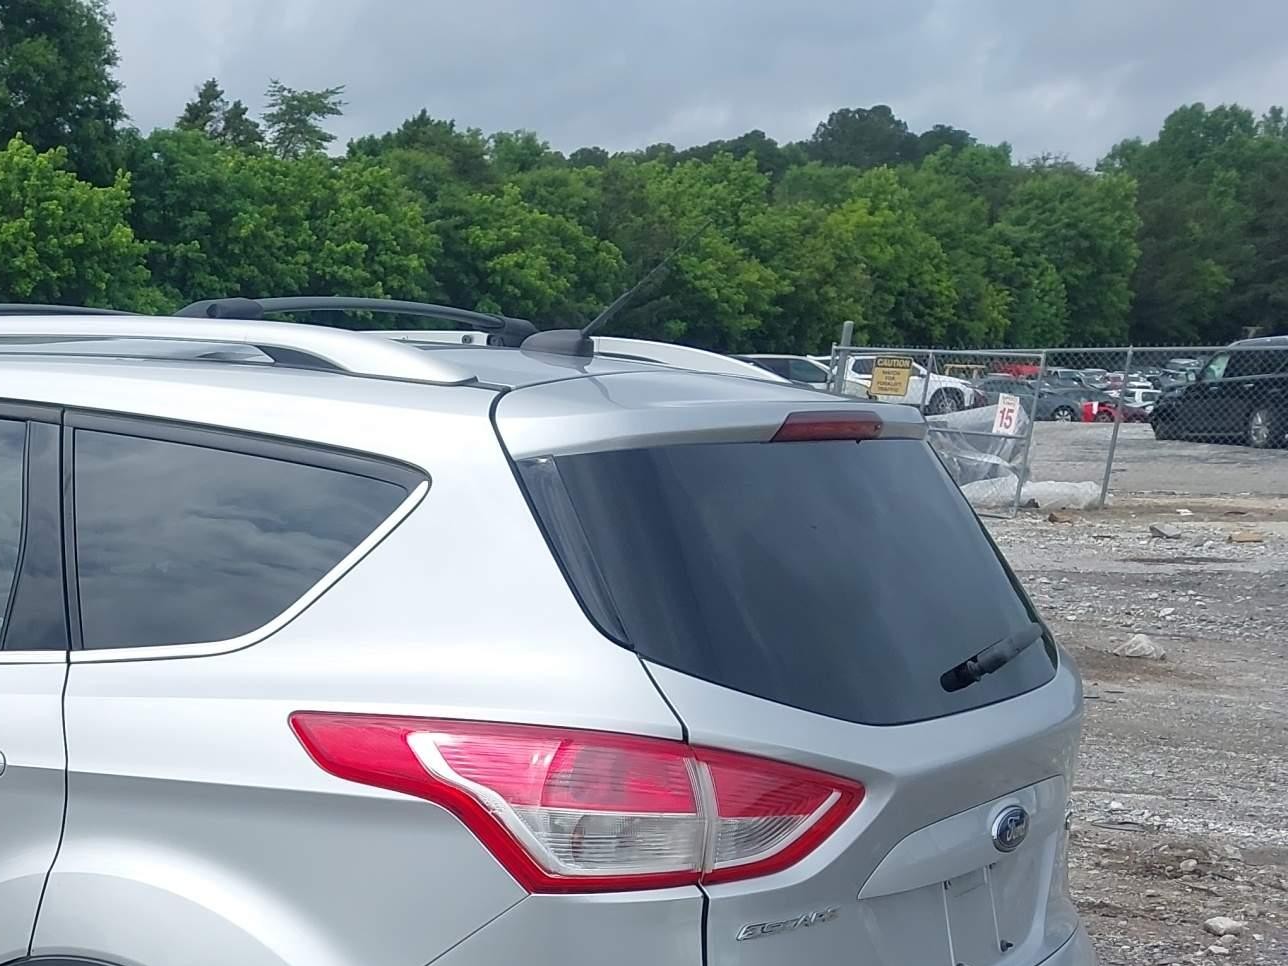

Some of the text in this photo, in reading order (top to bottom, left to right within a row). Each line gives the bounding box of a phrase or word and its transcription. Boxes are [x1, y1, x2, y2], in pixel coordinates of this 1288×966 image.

[877, 359, 910, 368] CAUTION
[999, 407, 1015, 430] 15
[735, 904, 841, 942] ESCAPE
